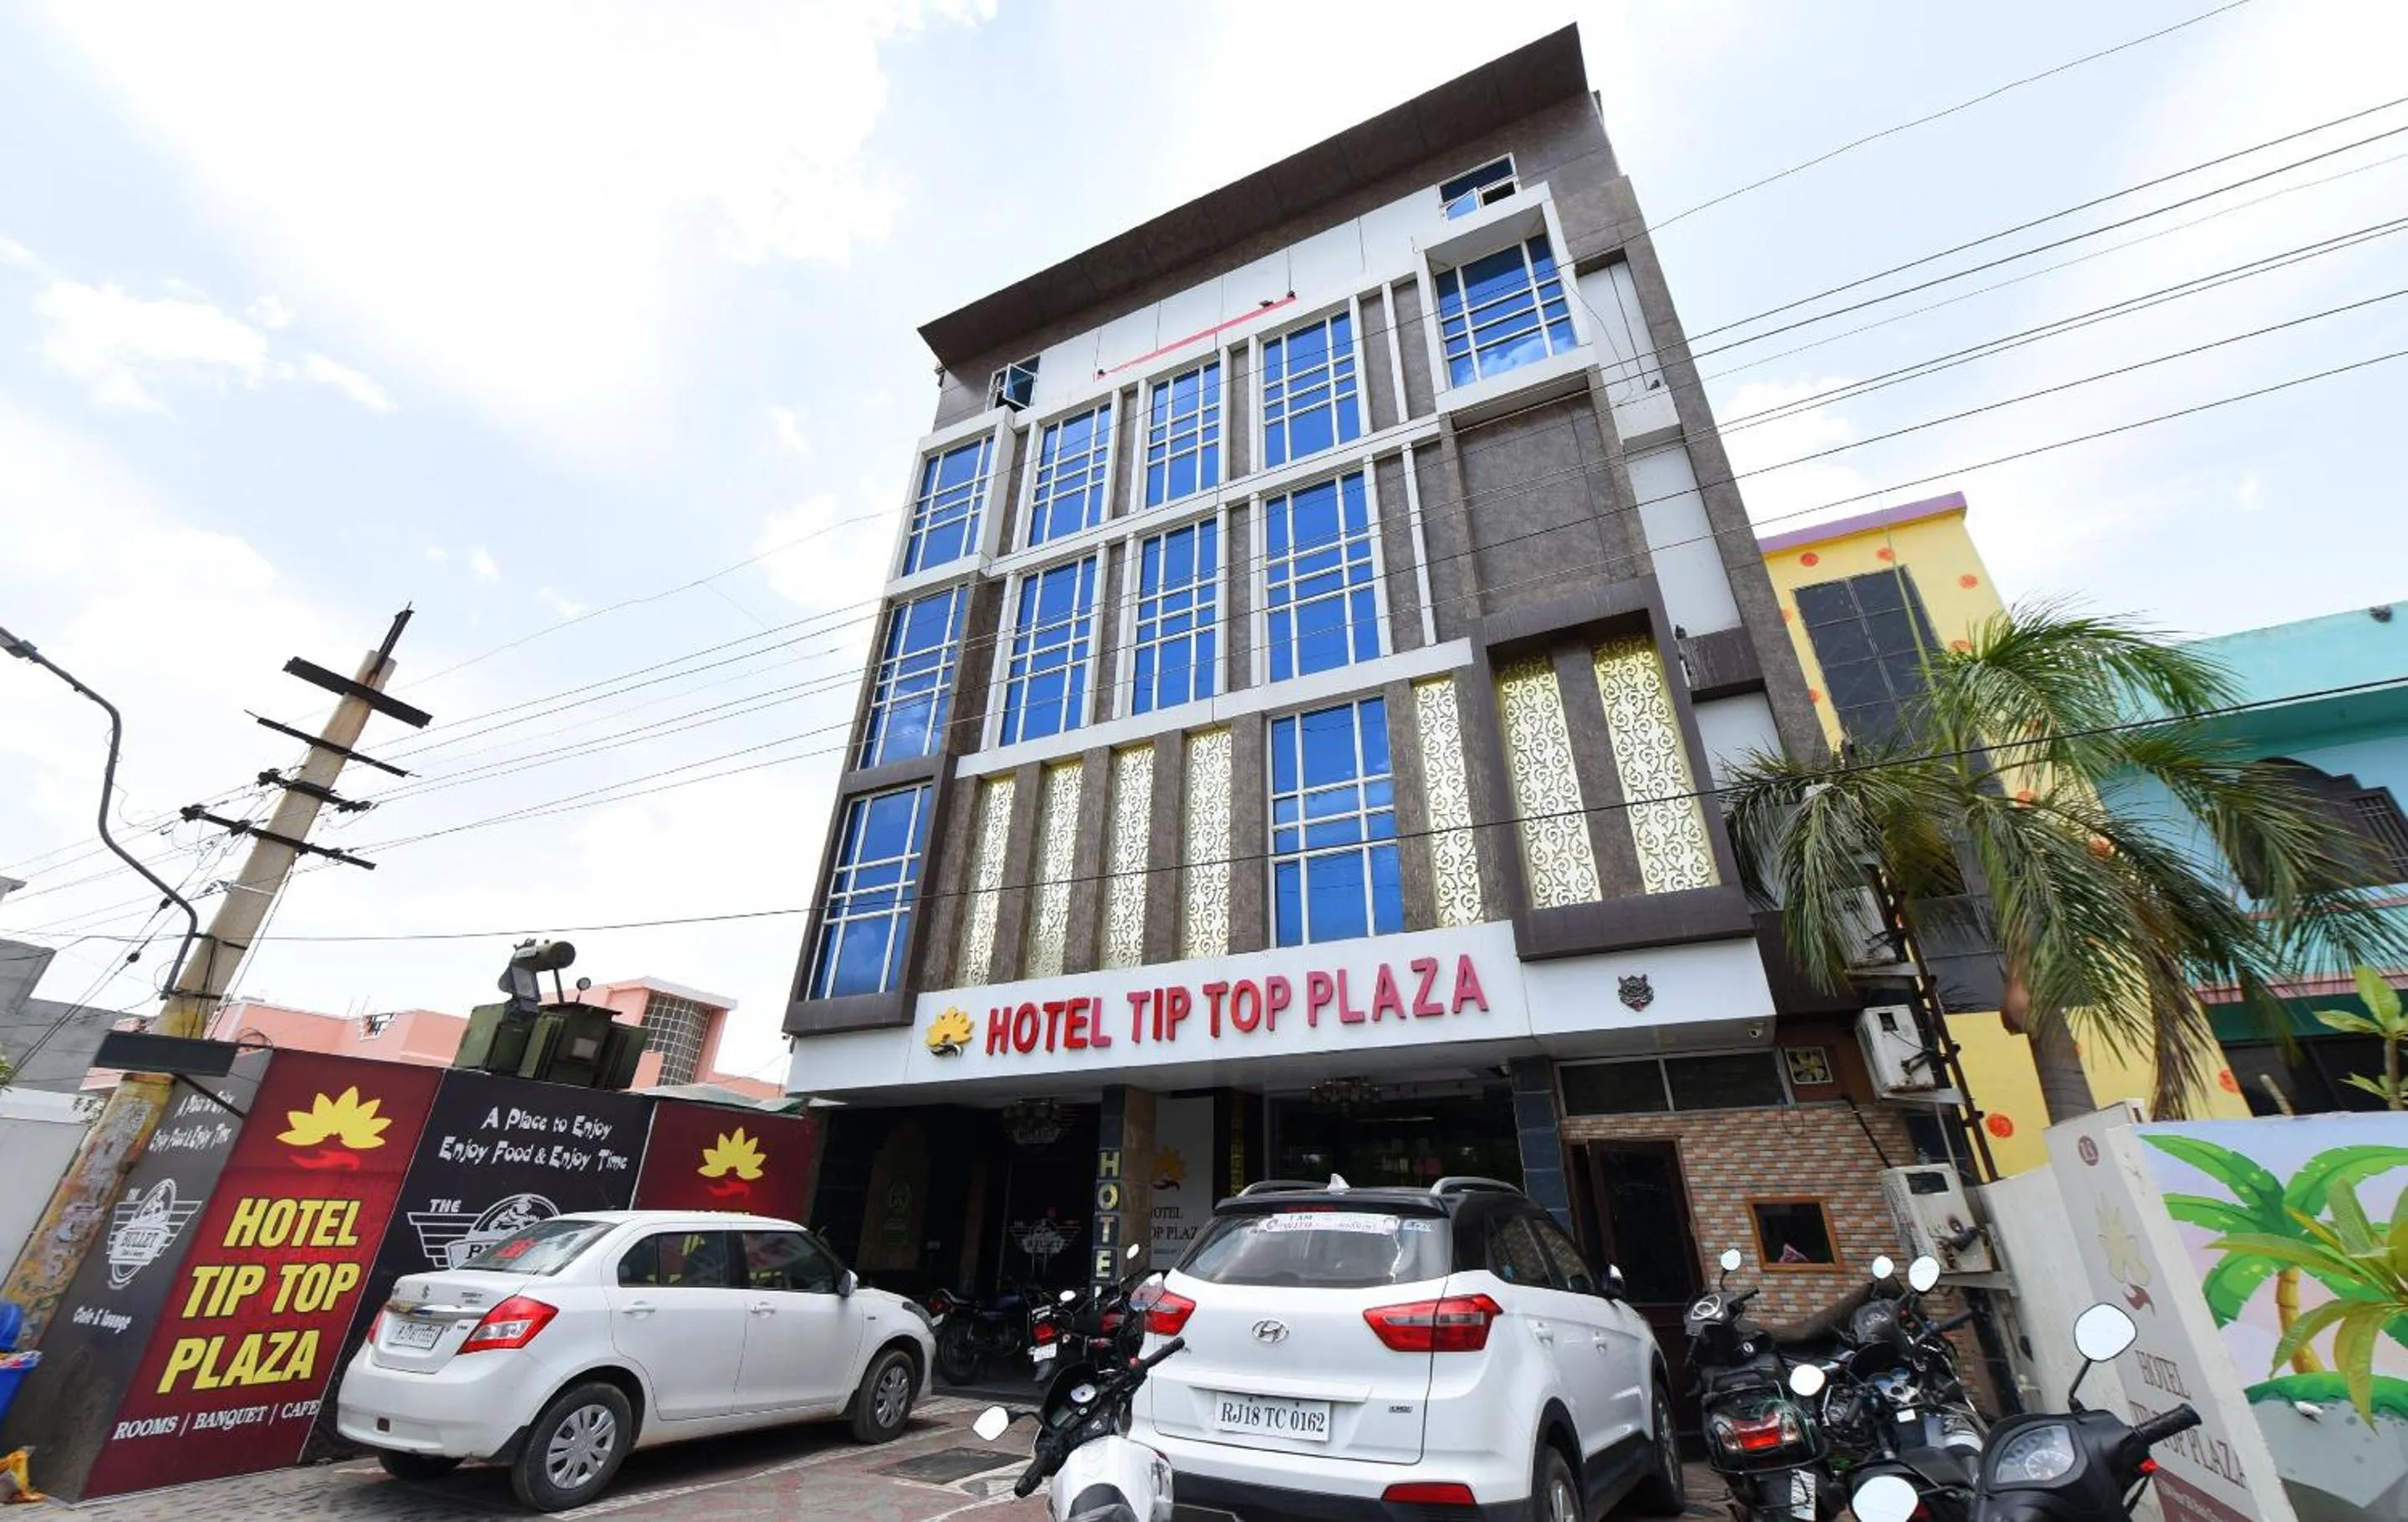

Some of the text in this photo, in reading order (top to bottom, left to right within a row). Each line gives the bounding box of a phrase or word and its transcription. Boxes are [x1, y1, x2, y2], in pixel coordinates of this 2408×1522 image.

[985, 953, 1489, 1055] HOTEL TIP TOP PLAZA
[480, 1106, 612, 1140] A Place to Enjoy
[438, 1136, 627, 1171] Enjoy Food & Enjoy Time
[222, 1198, 360, 1248] HOTEL
[429, 1198, 462, 1213] THE
[182, 1262, 360, 1318] TIP TOP
[156, 1329, 320, 1394] PLAZA
[2135, 1350, 2191, 1400] HOTEL
[111, 1416, 179, 1440] ROOMS
[192, 1406, 268, 1431] BANQUET
[1221, 1402, 1325, 1433] RJ18 TC 0162
